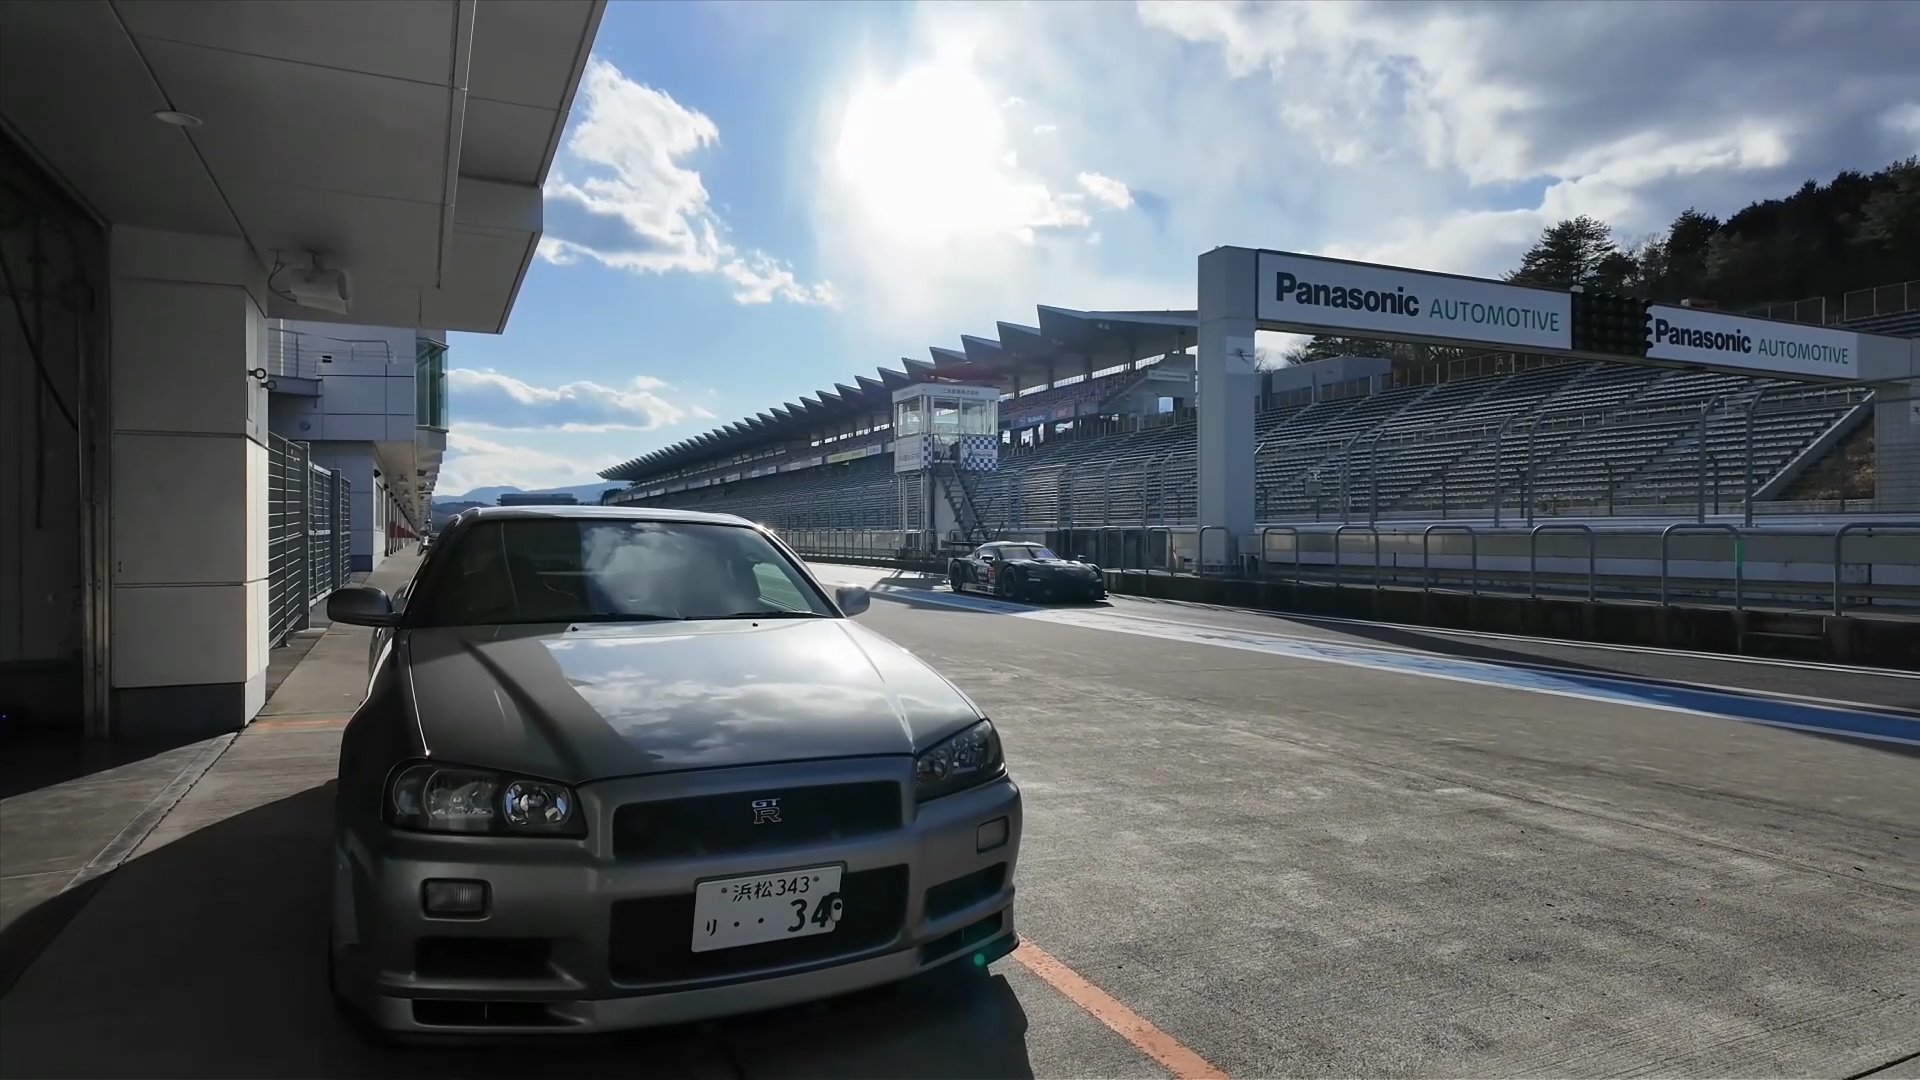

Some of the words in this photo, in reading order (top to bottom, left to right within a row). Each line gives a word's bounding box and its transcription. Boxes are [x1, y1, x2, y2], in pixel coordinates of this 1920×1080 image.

[1276, 271, 1419, 316] Panasonic
[1429, 298, 1559, 332] AUTOMOTIVE
[1655, 318, 1752, 354] Panasonic
[1758, 338, 1848, 364] AUTOMOTIVE
[1027, 415, 1046, 423] SUBARU
[752, 798, 781, 808] GT
[753, 807, 782, 825] R
[787, 898, 832, 933] 34
